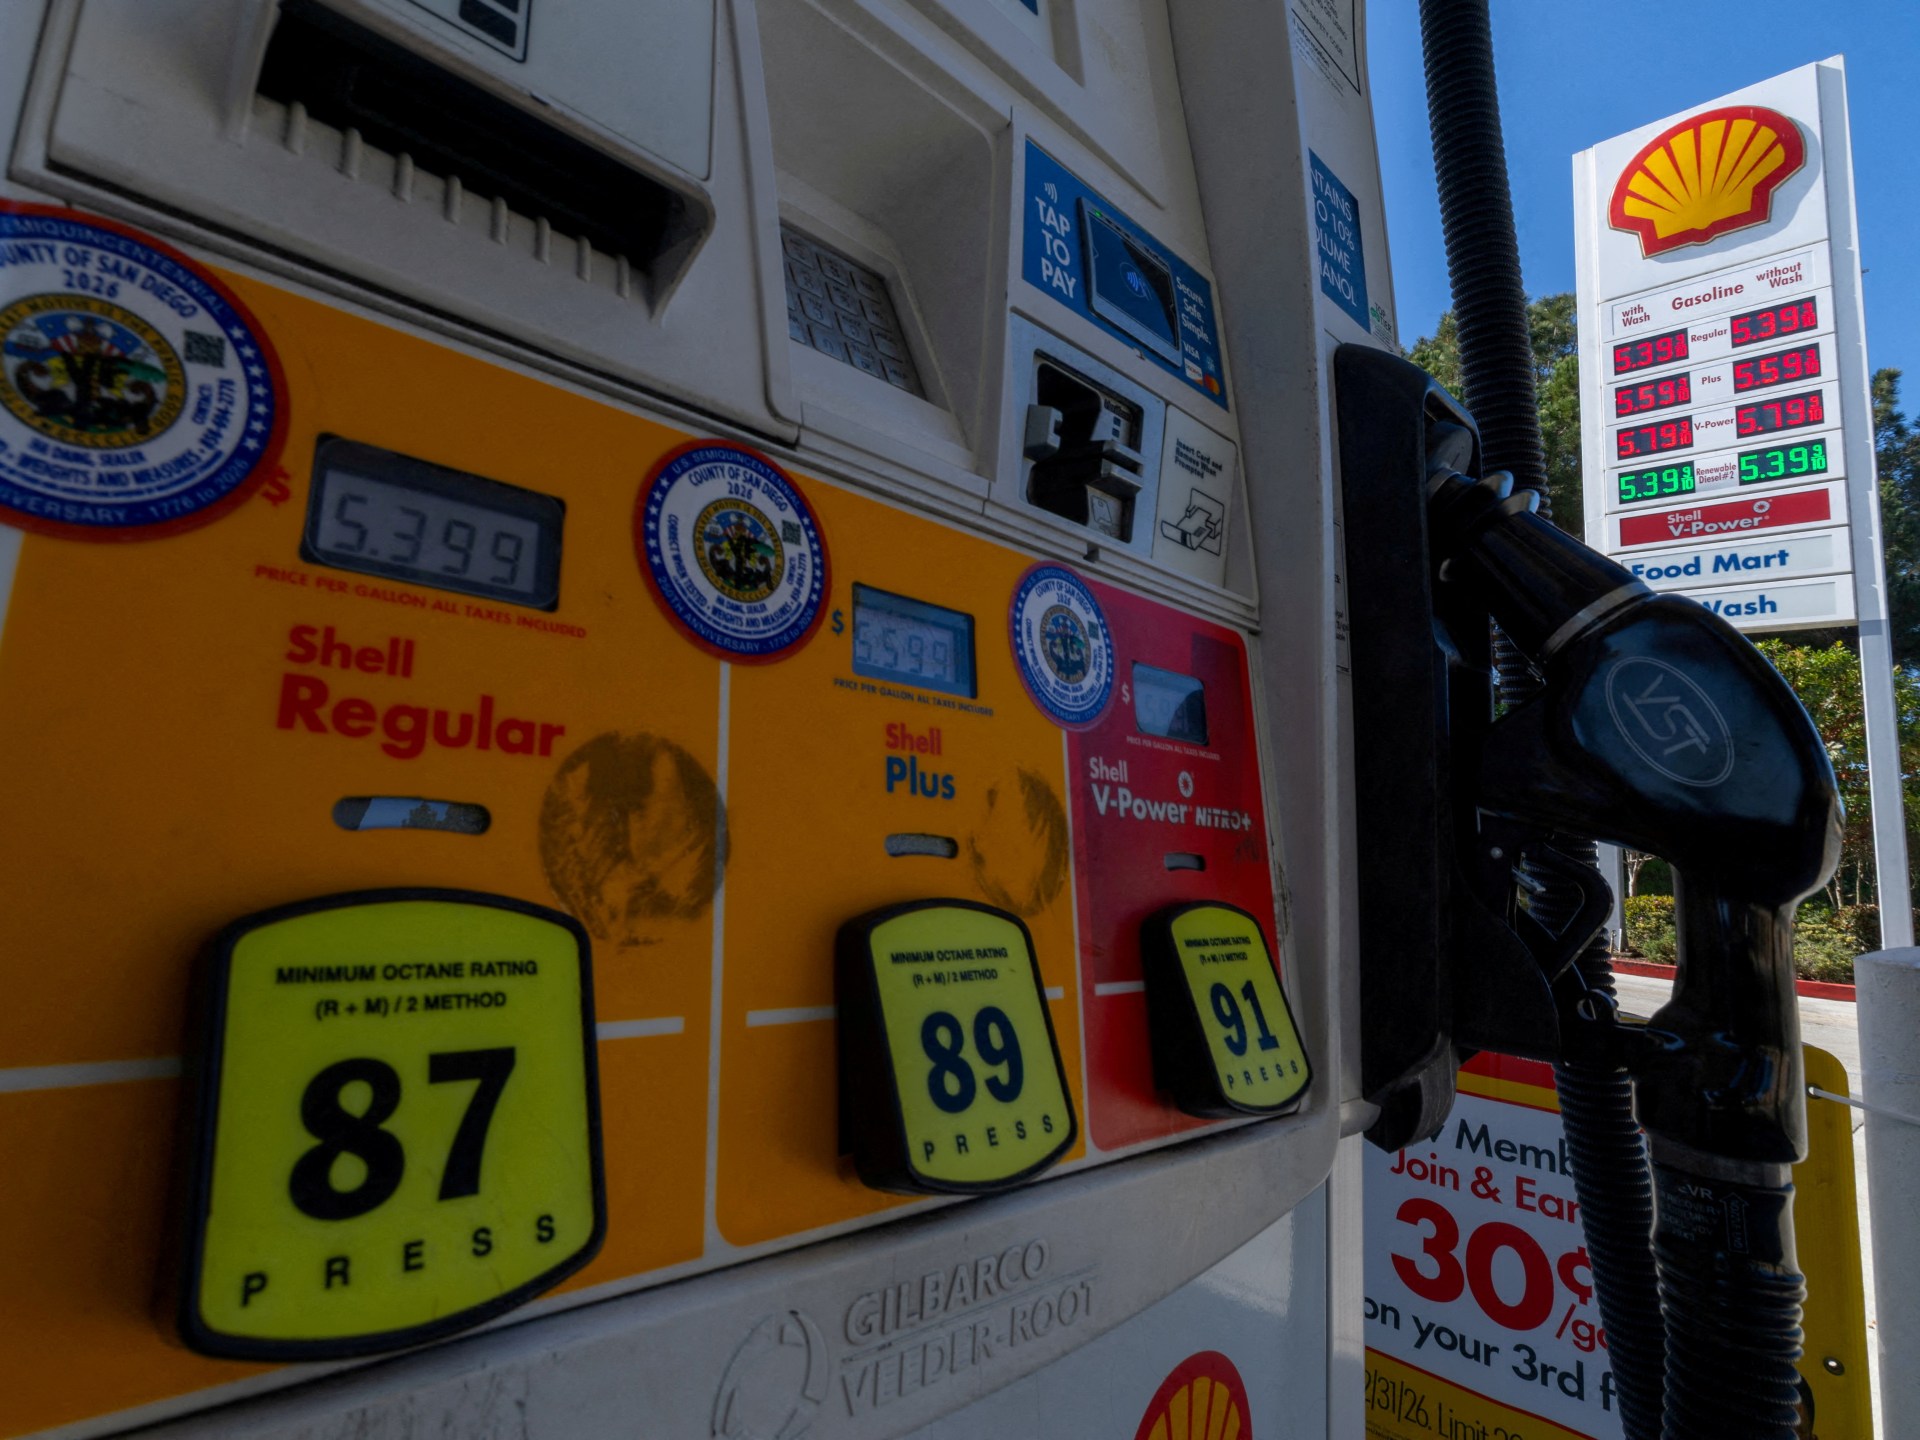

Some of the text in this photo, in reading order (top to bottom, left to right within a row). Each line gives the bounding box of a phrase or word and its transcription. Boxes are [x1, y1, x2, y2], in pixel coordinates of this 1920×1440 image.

[1035, 196, 1071, 238] TAP
[1331, 212, 1355, 252] 10%
[1042, 229, 1071, 267] TO
[63, 269, 120, 299] 2026
[65, 246, 198, 318] OF SAN DIEGO
[1041, 256, 1077, 299] PAY
[1755, 261, 1802, 282] without
[1769, 273, 1803, 289] Wash
[1176, 276, 1206, 309] Secure.
[1671, 284, 1744, 311] Gasoline
[1622, 304, 1644, 318] with
[1622, 313, 1651, 327] Wash
[1181, 312, 1212, 346] Simple.
[1690, 328, 1728, 343] Regular
[1182, 340, 1201, 361] VISA
[1701, 375, 1722, 385] Plus
[1694, 417, 1735, 431] V-Power
[18, 448, 202, 487] WEIGHTS AND MEASURES
[1196, 449, 1211, 466] Card
[1212, 458, 1223, 472] and
[1696, 463, 1737, 476] Renewable
[149, 457, 250, 520] 1776 2026
[671, 448, 802, 511] U.S. SEMIQUINCENTENNIAL
[687, 465, 788, 513] COUNTY OF SAN DIEGO
[727, 482, 754, 500] 2026
[261, 464, 523, 586] $ 5.399
[1667, 510, 1702, 524] Shell
[1668, 516, 1763, 538] V-Power
[1631, 550, 1790, 581] Food Mart
[254, 564, 588, 640] PRICE PER GALLON ALL TAXES INCLUDED
[682, 574, 708, 610] TESTED
[710, 604, 745, 628] WEIGHTS
[745, 613, 761, 628] AND
[760, 600, 793, 628] MEASURES
[1035, 579, 1091, 615] COUNTY OF SAN DIEGO
[683, 611, 761, 654] ANNIVERSARY
[831, 609, 845, 636] $
[286, 623, 417, 679] Shell
[833, 678, 995, 717] PRICE PER GALLON ALL TAXES INCLUDED
[1121, 682, 1130, 705] $
[276, 673, 567, 760] Regular
[885, 722, 943, 756] Shell
[1153, 740, 1175, 753] GALLON
[1175, 744, 1183, 753] ALL
[1183, 746, 1198, 758] TAXES
[1198, 749, 1221, 761] INCLUDED
[885, 755, 956, 800] Plus
[1089, 757, 1129, 783] Shell
[1091, 783, 1189, 825] V-Power
[890, 947, 1009, 965] MINIMUM OCTANE RATING
[1184, 936, 1252, 948] MINIMUM OCTANE RATING
[1225, 951, 1248, 962] METHOD
[276, 960, 538, 985] MINIMUM OCTANE RATING
[959, 968, 999, 983] METHOD
[405, 995, 420, 1012] 2
[423, 991, 507, 1011] METHOD
[1210, 979, 1280, 1057] 91
[921, 1006, 1025, 1115] 89
[1226, 1059, 1299, 1090] PRESS
[288, 1046, 516, 1222] 87
[923, 1114, 1054, 1163] PRESS
[1390, 1148, 1460, 1191] Join
[1470, 1165, 1503, 1205] &
[240, 1213, 556, 1308] PRESS
[842, 1238, 1051, 1348] GILBARCO
[841, 1278, 1095, 1418] VEEDER-ROOT
[1412, 1314, 1501, 1366] your
[1511, 1343, 1586, 1402] 3rd
[1438, 1402, 1490, 1440] Limit
